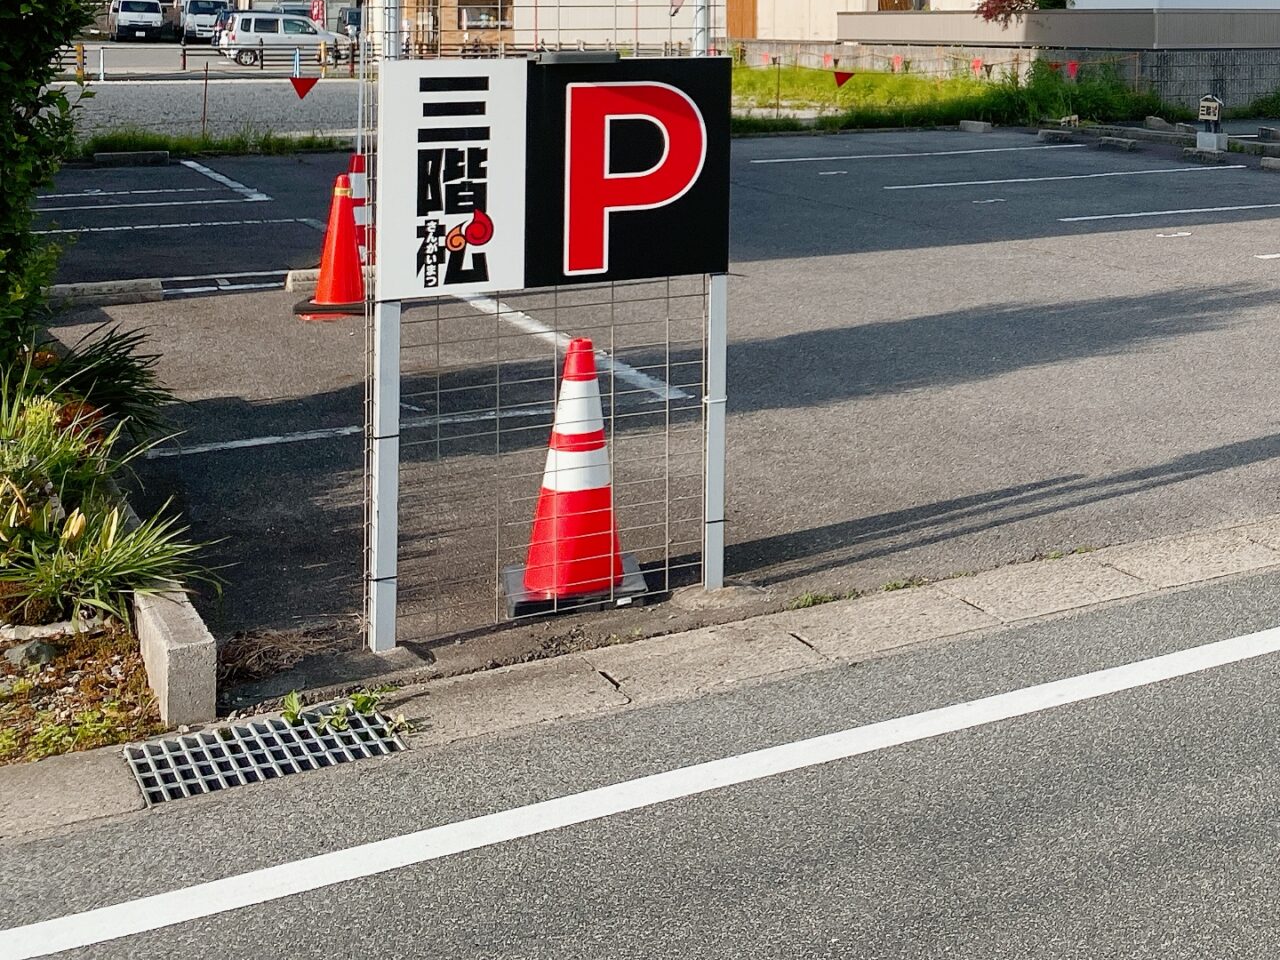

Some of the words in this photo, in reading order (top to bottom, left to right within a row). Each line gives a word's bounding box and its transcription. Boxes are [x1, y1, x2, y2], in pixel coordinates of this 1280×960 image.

[416, 76, 494, 286] 三階松
[424, 220, 438, 287] さんがいまつ
[563, 81, 708, 277] P
